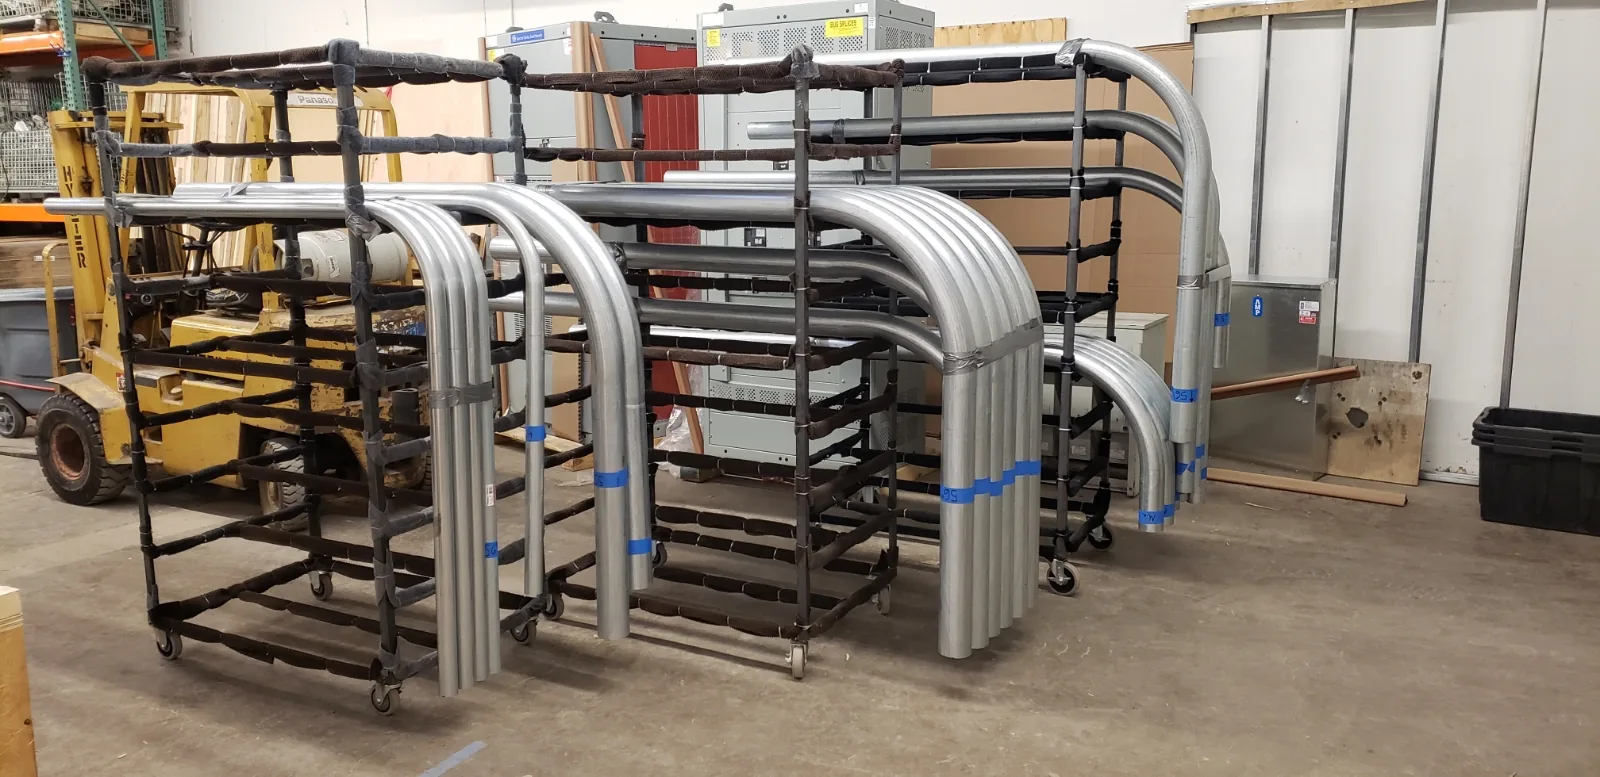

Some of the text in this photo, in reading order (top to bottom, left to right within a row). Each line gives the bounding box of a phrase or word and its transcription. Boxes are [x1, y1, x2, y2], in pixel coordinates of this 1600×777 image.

[839, 19, 857, 28] SPLICES
[297, 95, 337, 104] Panaso
[62, 165, 87, 269] HYTER
